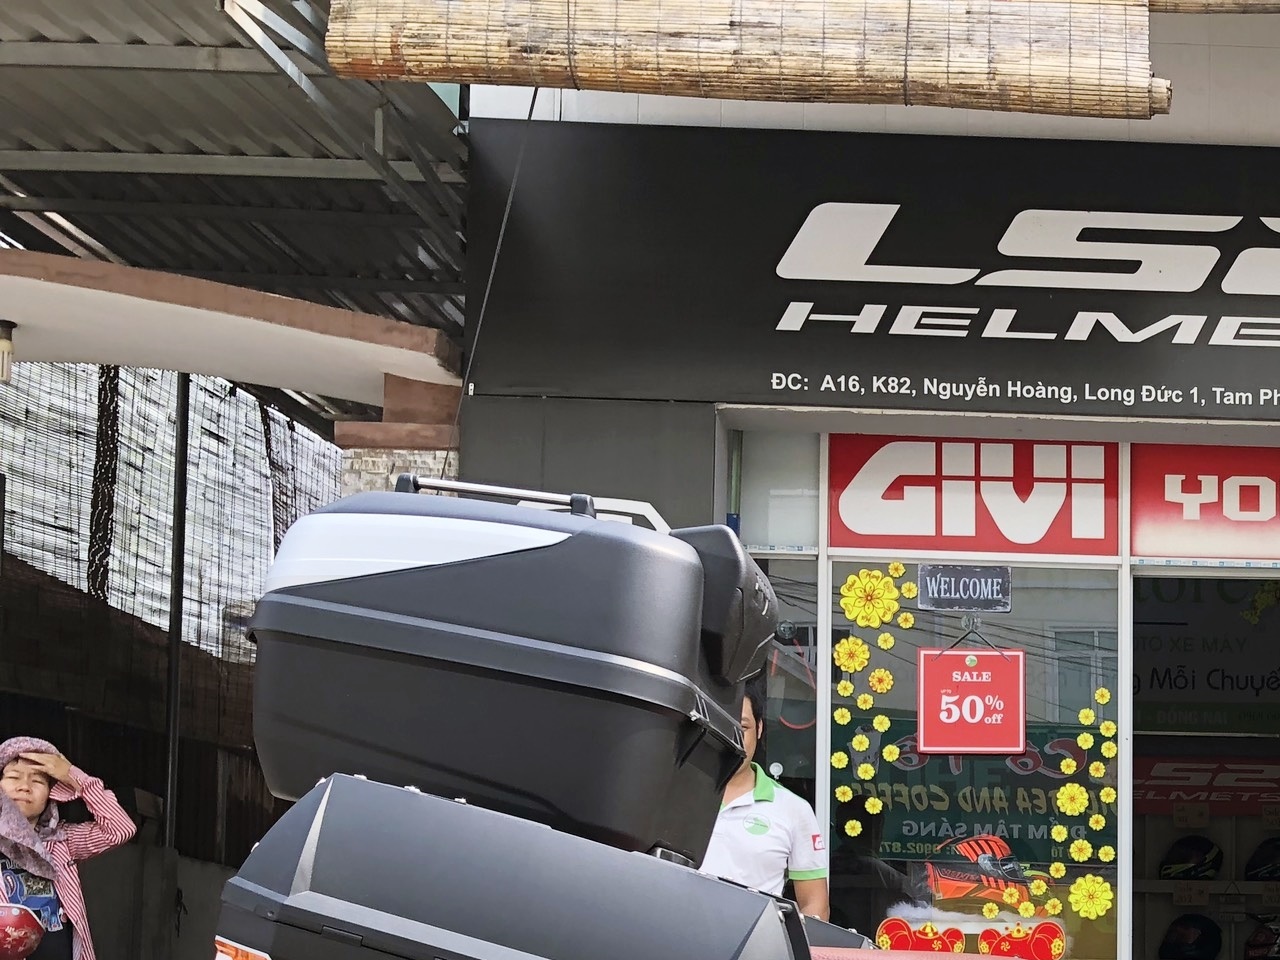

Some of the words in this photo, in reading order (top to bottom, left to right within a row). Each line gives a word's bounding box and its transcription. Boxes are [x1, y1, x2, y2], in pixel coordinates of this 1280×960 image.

[771, 372, 809, 391] ĐC:
[820, 374, 865, 396] A16,
[872, 376, 917, 397] K82,
[923, 376, 1000, 400] Nguyễn
[1007, 380, 1078, 403] Hoàng,
[1085, 383, 1135, 405] Long
[1141, 385, 1183, 402] Đức
[1189, 386, 1206, 406] 1,
[1212, 387, 1253, 405] Tam
[838, 440, 1105, 545] GIVI
[926, 573, 1003, 600] WELCOME
[1169, 636, 1195, 652] XE
[952, 671, 992, 683] SALE
[1150, 664, 1196, 690] Mỗi
[984, 713, 1004, 725] off
